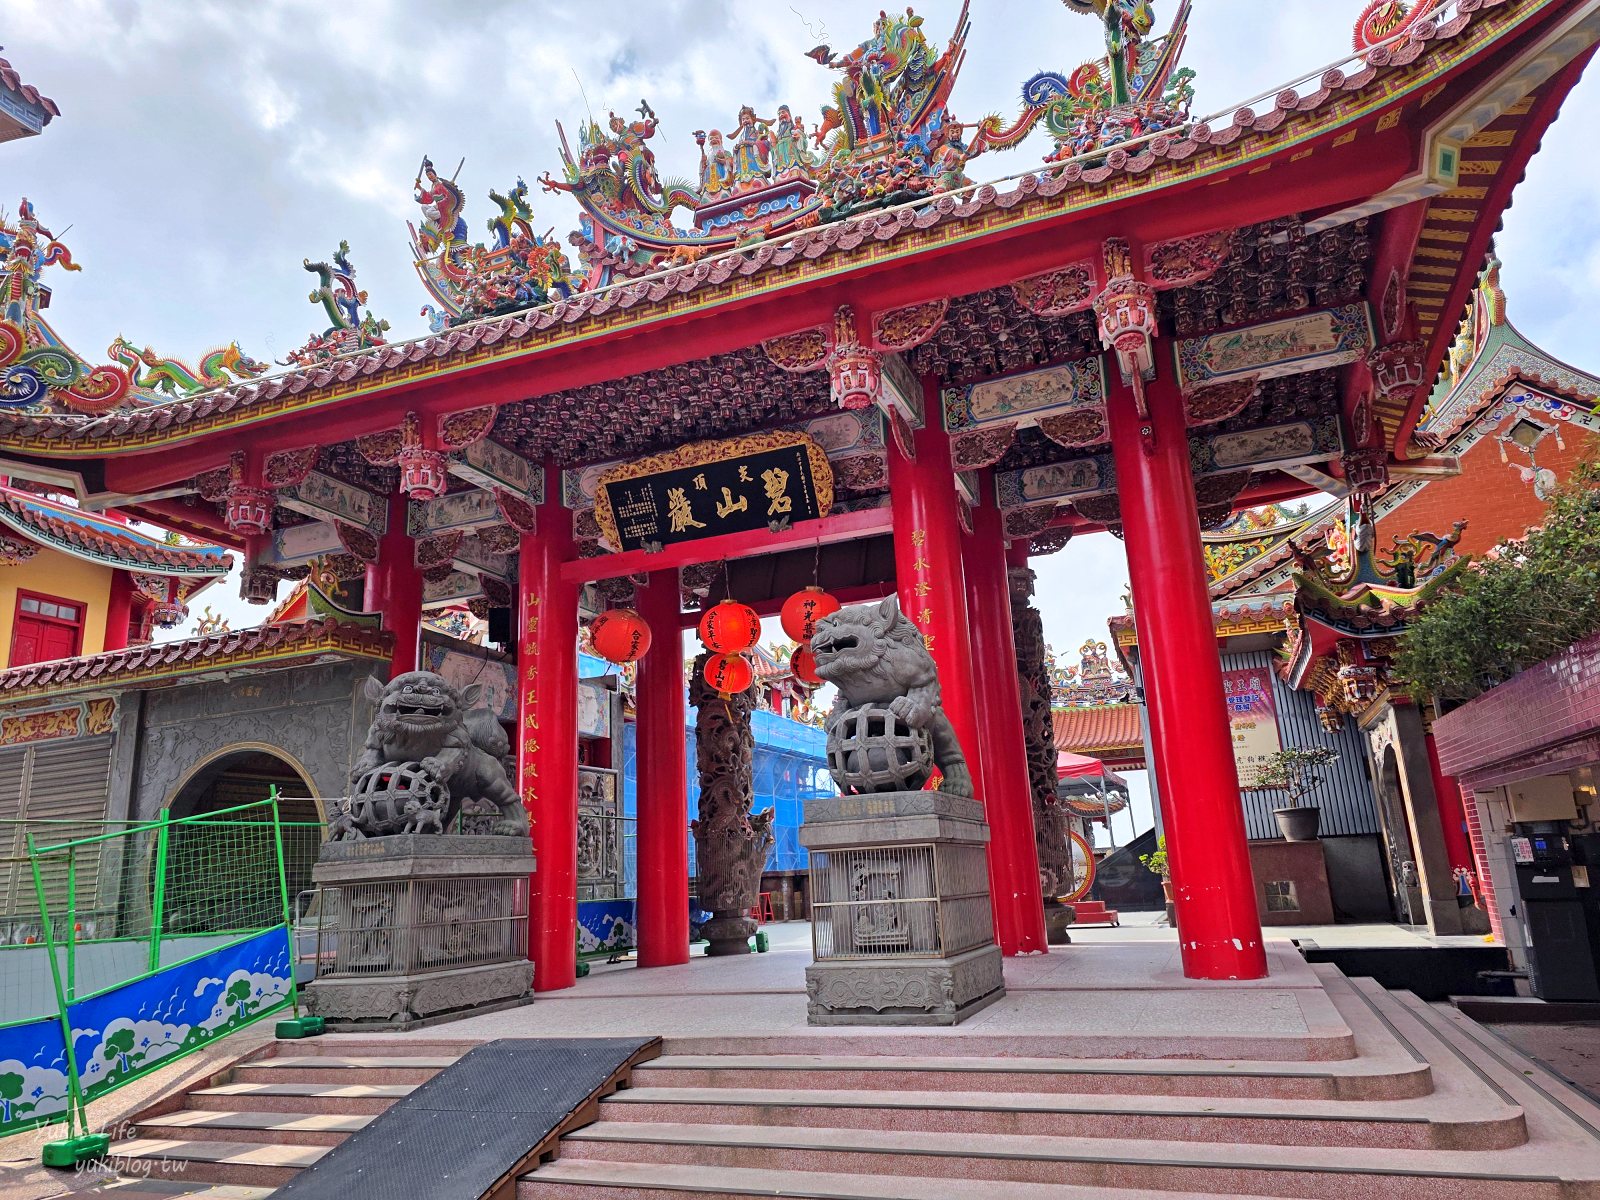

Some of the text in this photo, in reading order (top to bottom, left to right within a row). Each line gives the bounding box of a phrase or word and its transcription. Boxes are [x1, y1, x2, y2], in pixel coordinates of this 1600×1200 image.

[666, 467, 792, 533] 碧山巖
[706, 610, 722, 649] 合家平安
